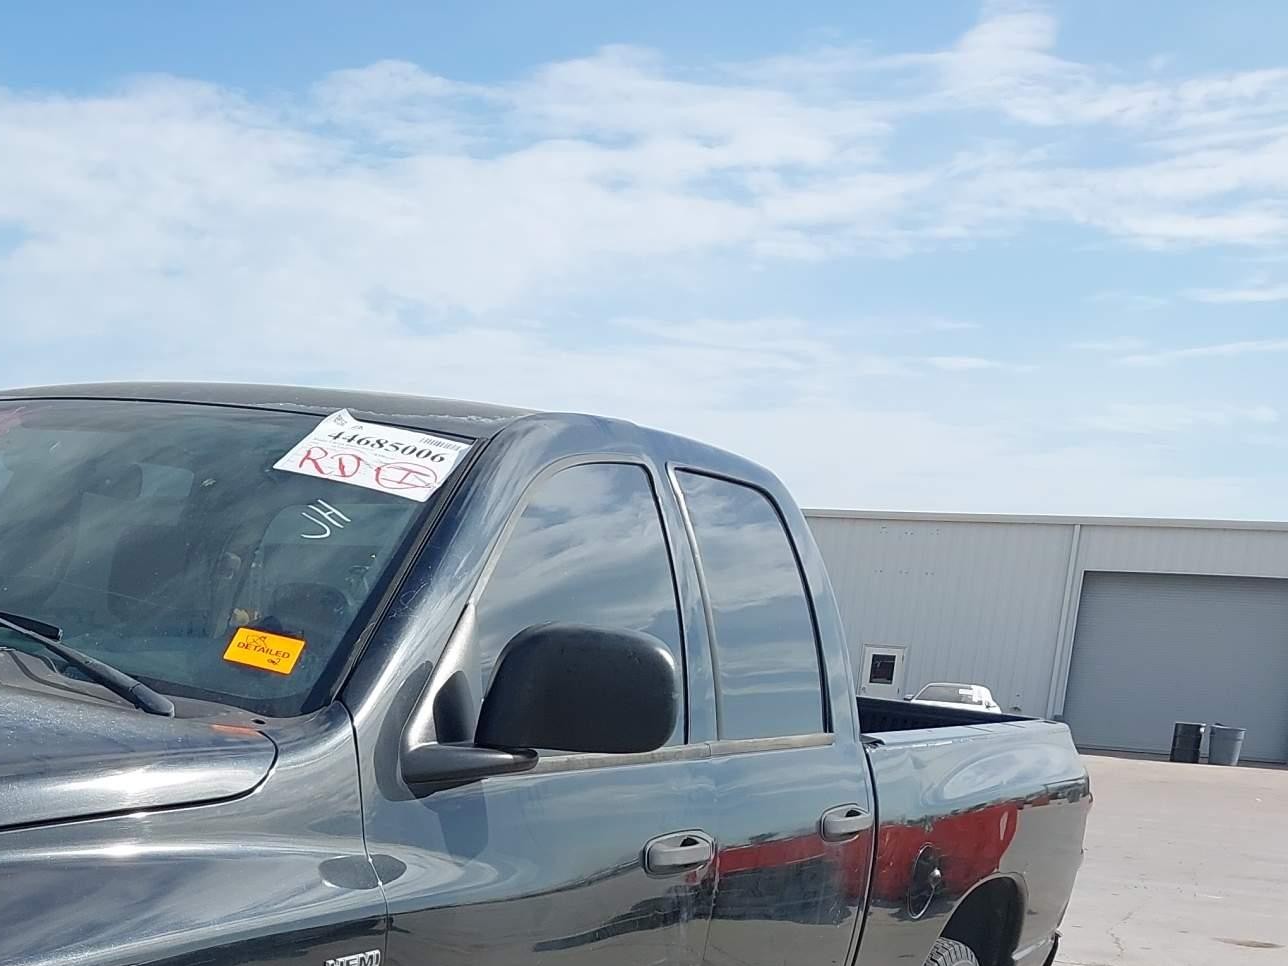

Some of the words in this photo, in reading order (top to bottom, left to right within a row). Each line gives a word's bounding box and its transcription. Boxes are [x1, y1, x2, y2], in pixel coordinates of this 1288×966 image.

[299, 446, 362, 478] RD
[328, 431, 446, 464] 44685006
[237, 641, 291, 659] DETAILED
